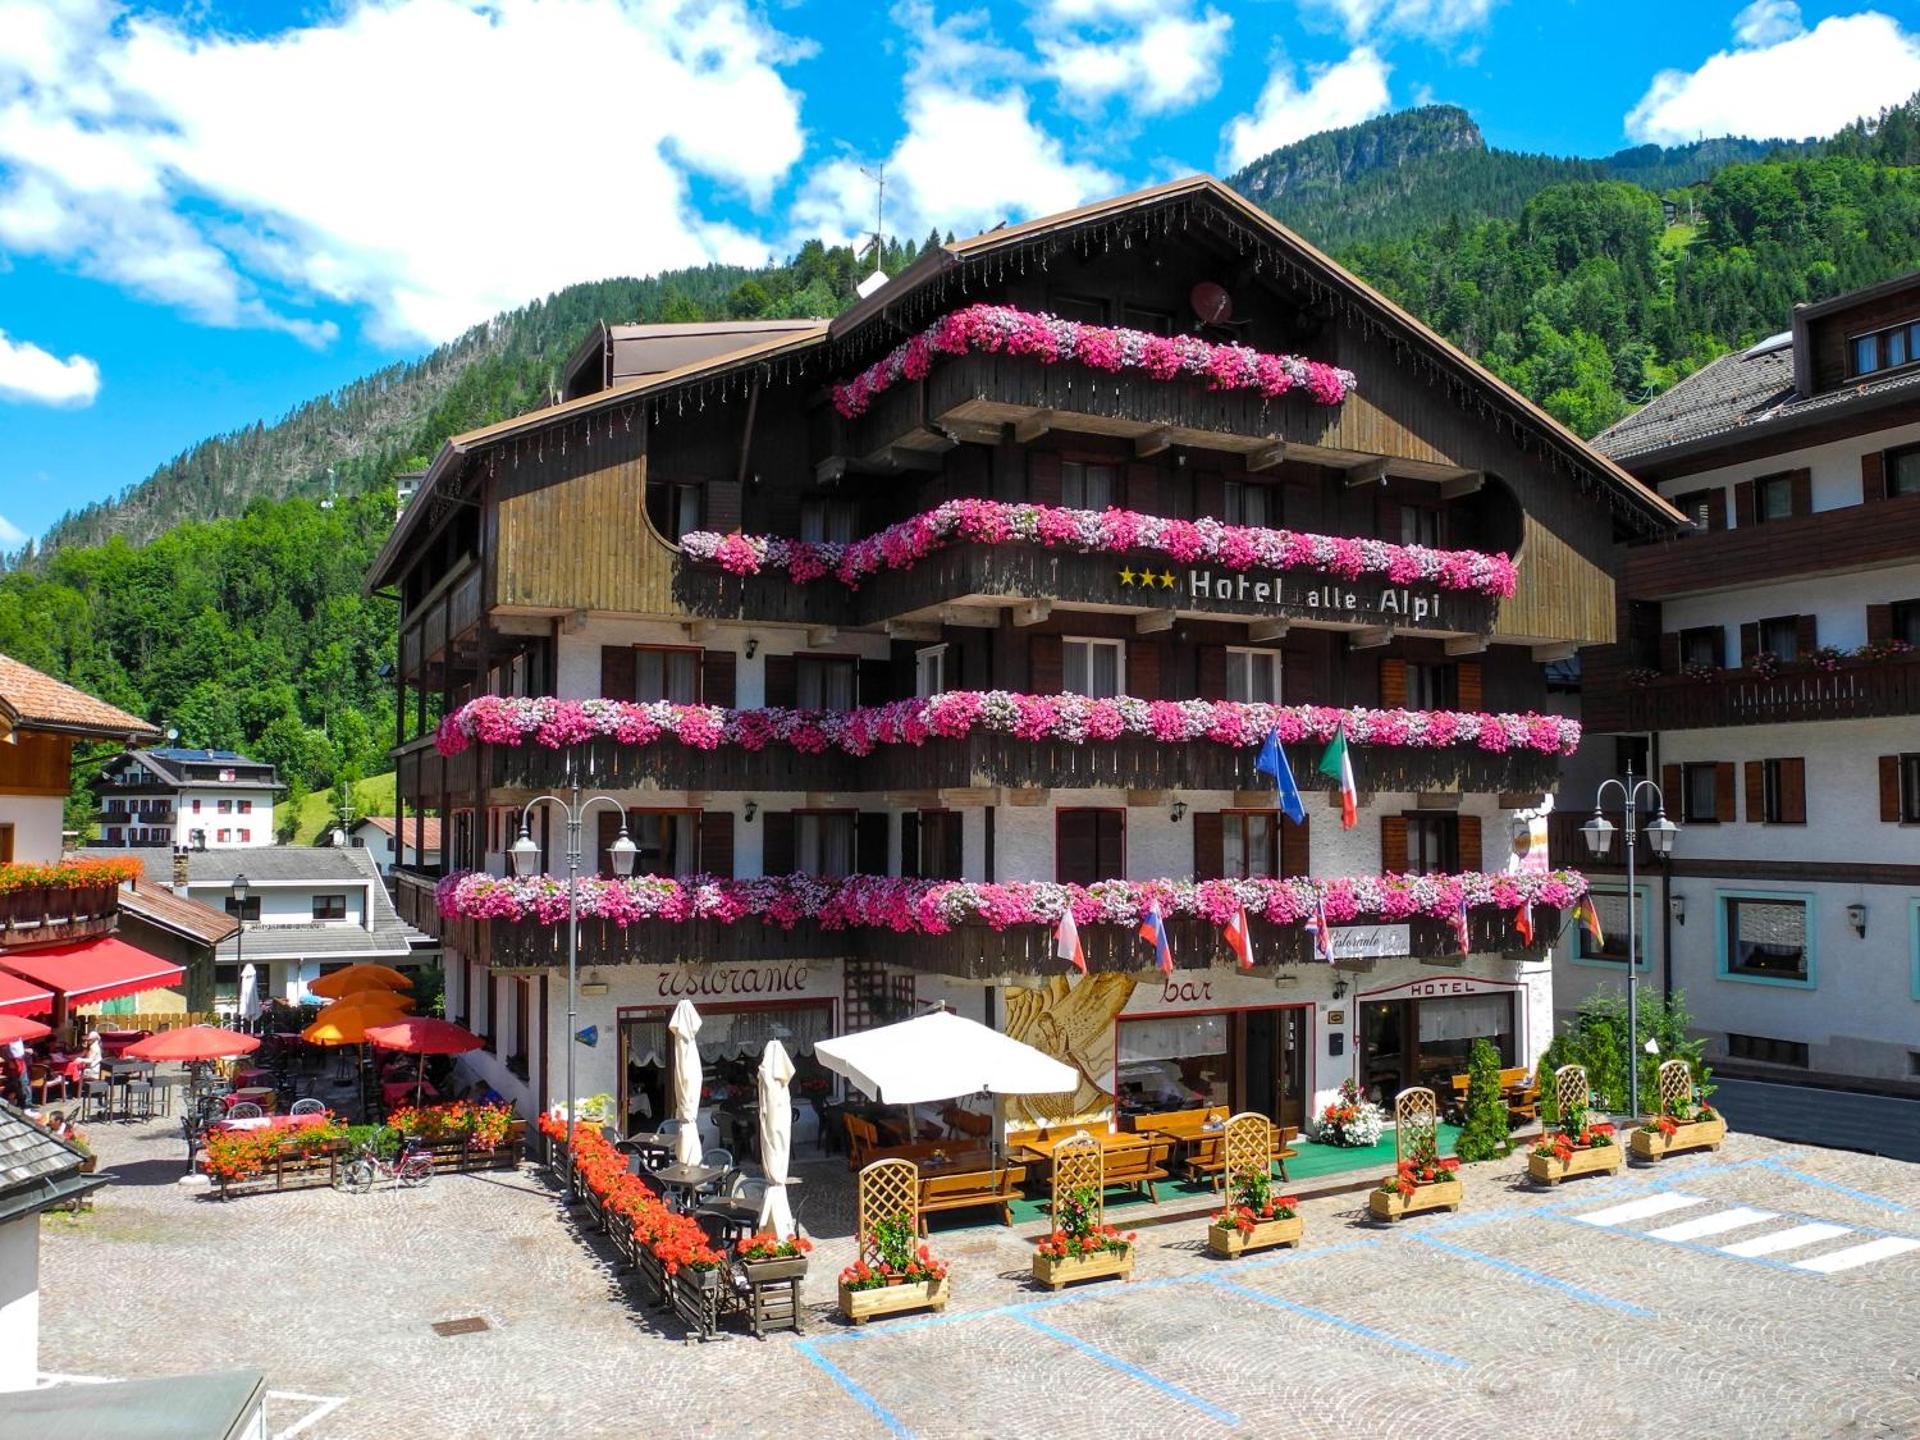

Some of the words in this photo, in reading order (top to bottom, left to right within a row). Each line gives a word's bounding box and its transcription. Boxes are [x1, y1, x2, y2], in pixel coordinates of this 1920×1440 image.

[1189, 569, 1282, 604] Hotel
[1308, 586, 1357, 609] alle
[1380, 588, 1440, 622] Alpi
[1333, 928, 1381, 952] istorante
[657, 961, 808, 997] ristorante
[1159, 977, 1213, 1003] bar
[1411, 982, 1475, 996] HOTEL
